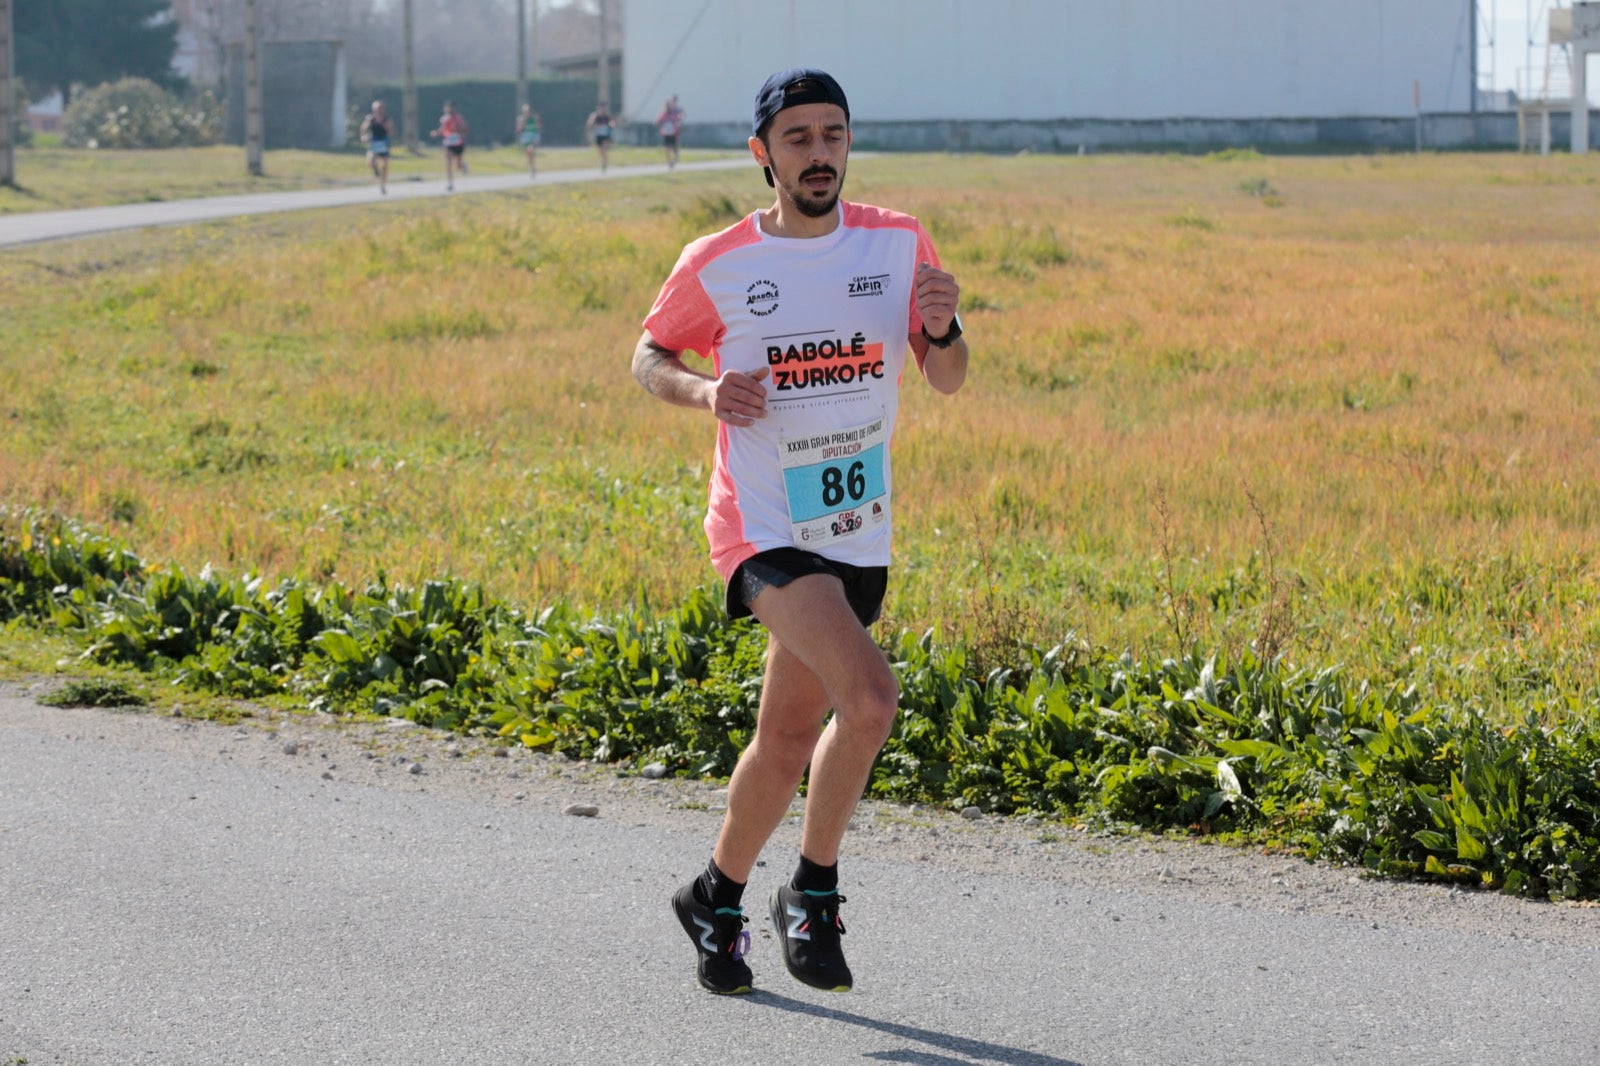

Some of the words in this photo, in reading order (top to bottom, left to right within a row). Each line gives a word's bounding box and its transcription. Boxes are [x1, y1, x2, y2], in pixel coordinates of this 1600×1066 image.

[767, 332, 866, 365] BABOLÉ
[775, 363, 855, 391] ZURKO
[858, 360, 885, 382] FC
[786, 439, 809, 453] XXXIII
[811, 436, 830, 449] GRAN
[831, 431, 858, 444] PREMIO
[859, 427, 866, 439] DE
[821, 460, 865, 507] 86
